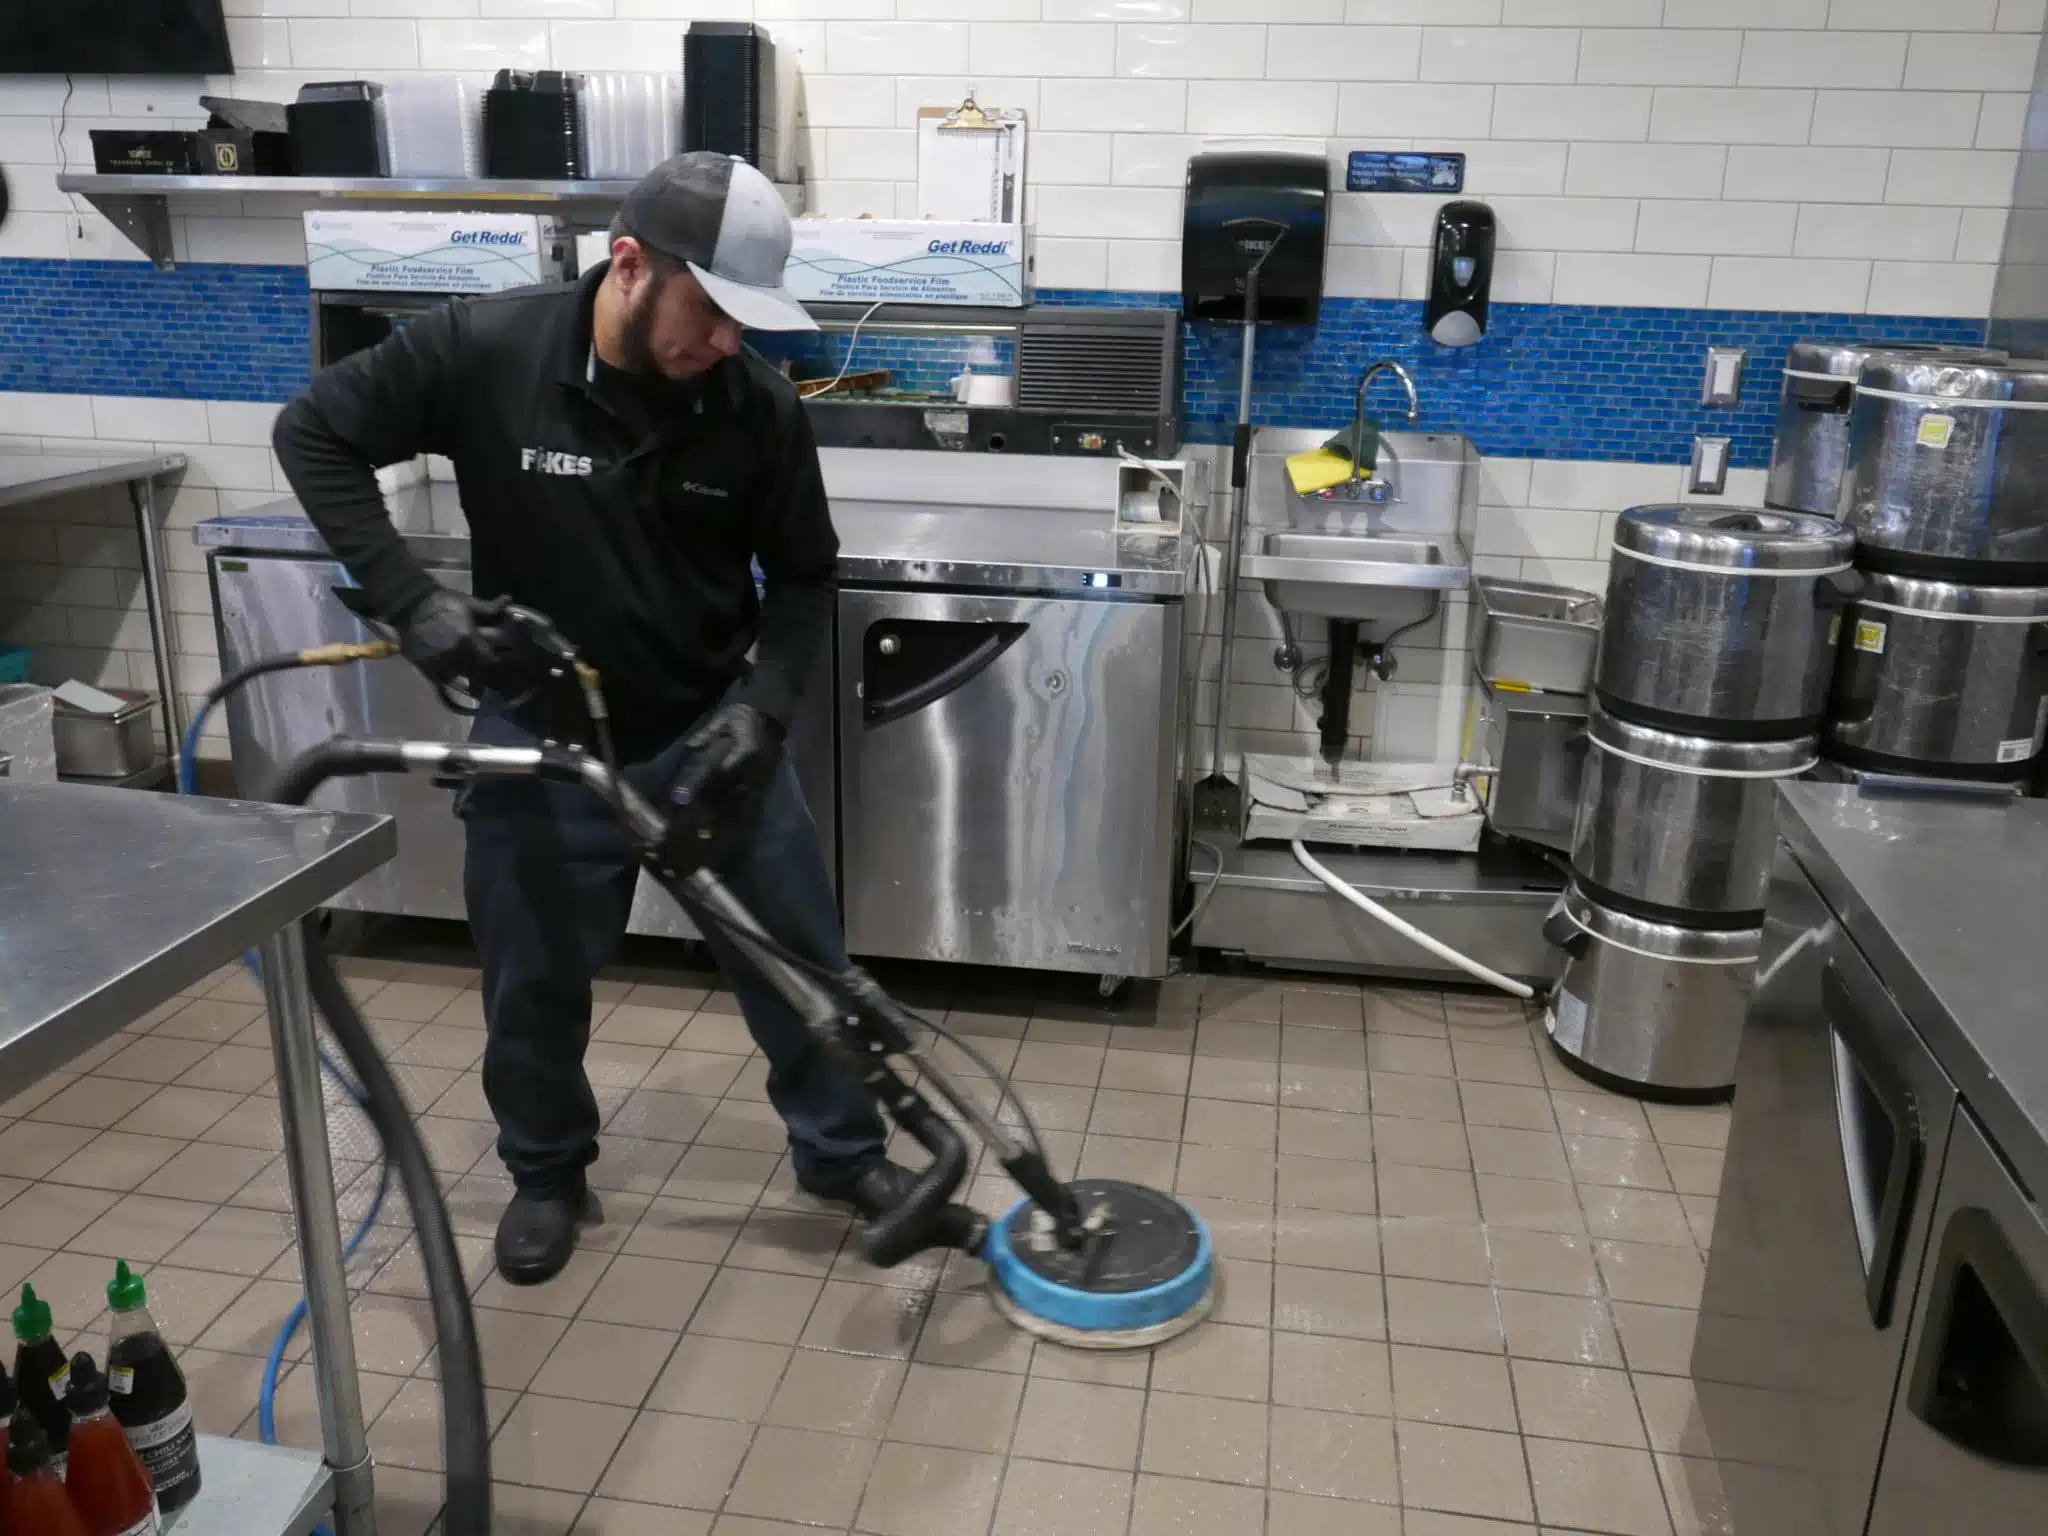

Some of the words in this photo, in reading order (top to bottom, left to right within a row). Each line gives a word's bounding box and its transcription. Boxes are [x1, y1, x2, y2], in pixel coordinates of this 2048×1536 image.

[451, 231, 479, 245] Get
[480, 231, 524, 246] Reddi
[928, 239, 958, 254] Get
[960, 240, 1007, 255] Reddi
[455, 266, 474, 275] Film
[838, 274, 867, 284] Plastic
[871, 275, 928, 286] Foodservice
[930, 277, 950, 286] Film
